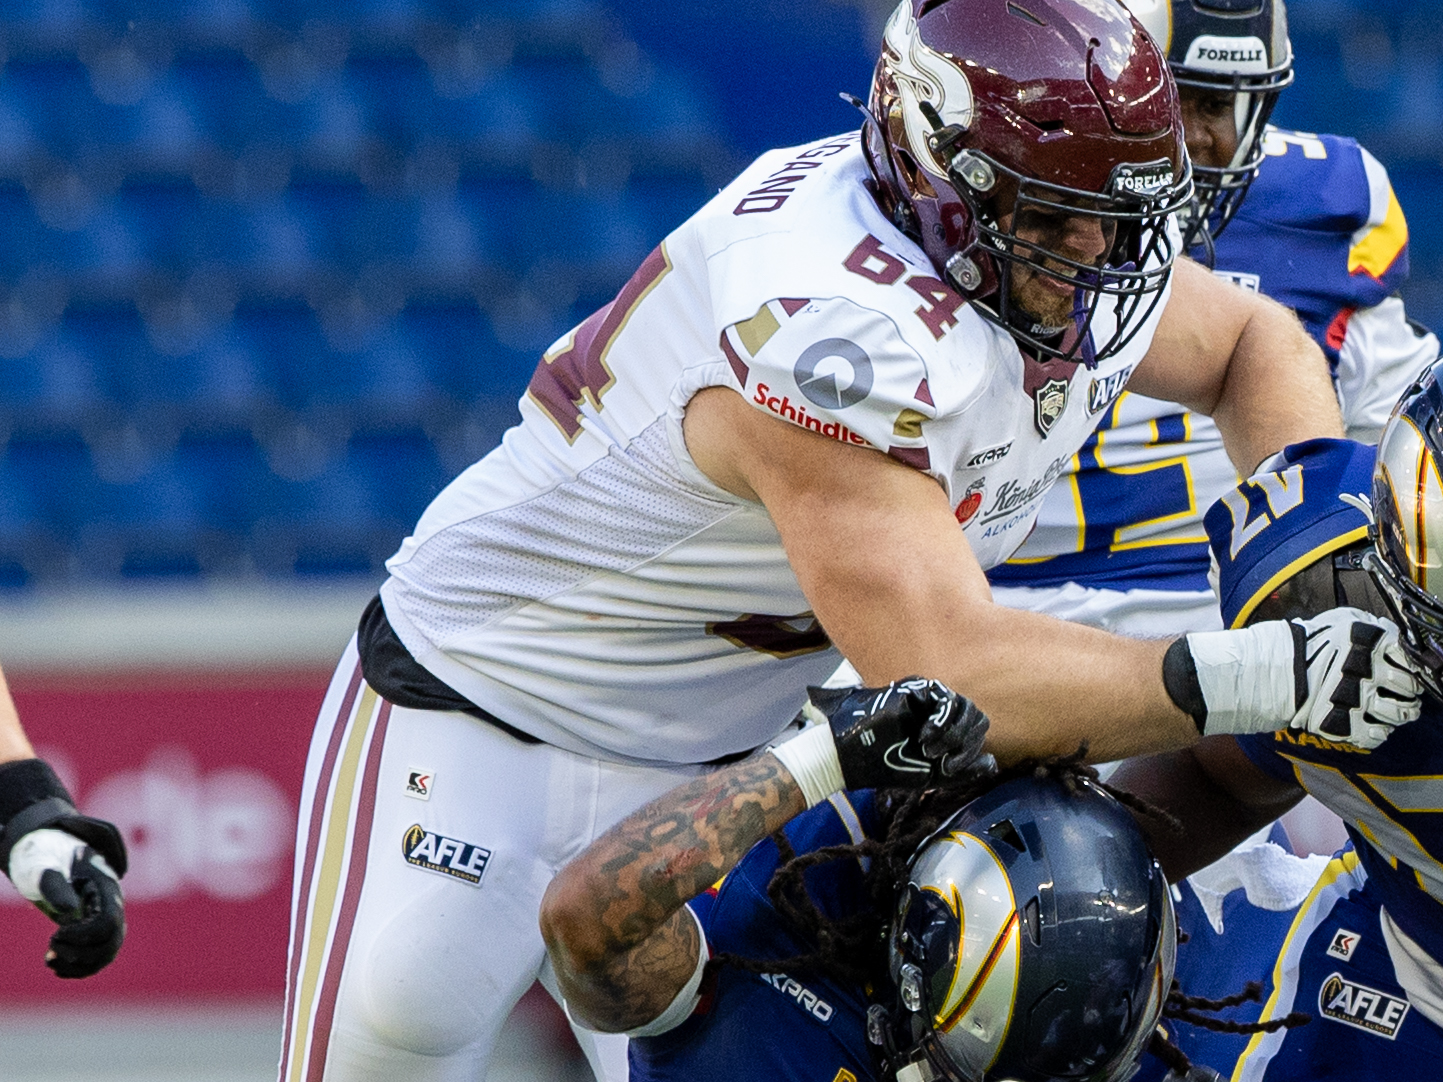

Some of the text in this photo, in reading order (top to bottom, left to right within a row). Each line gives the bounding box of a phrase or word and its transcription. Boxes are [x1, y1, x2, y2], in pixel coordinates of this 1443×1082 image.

[1197, 48, 1263, 62] FORELLE
[841, 232, 984, 342] 64
[409, 832, 490, 877] AFLE
[1327, 985, 1405, 1030] AFLE
